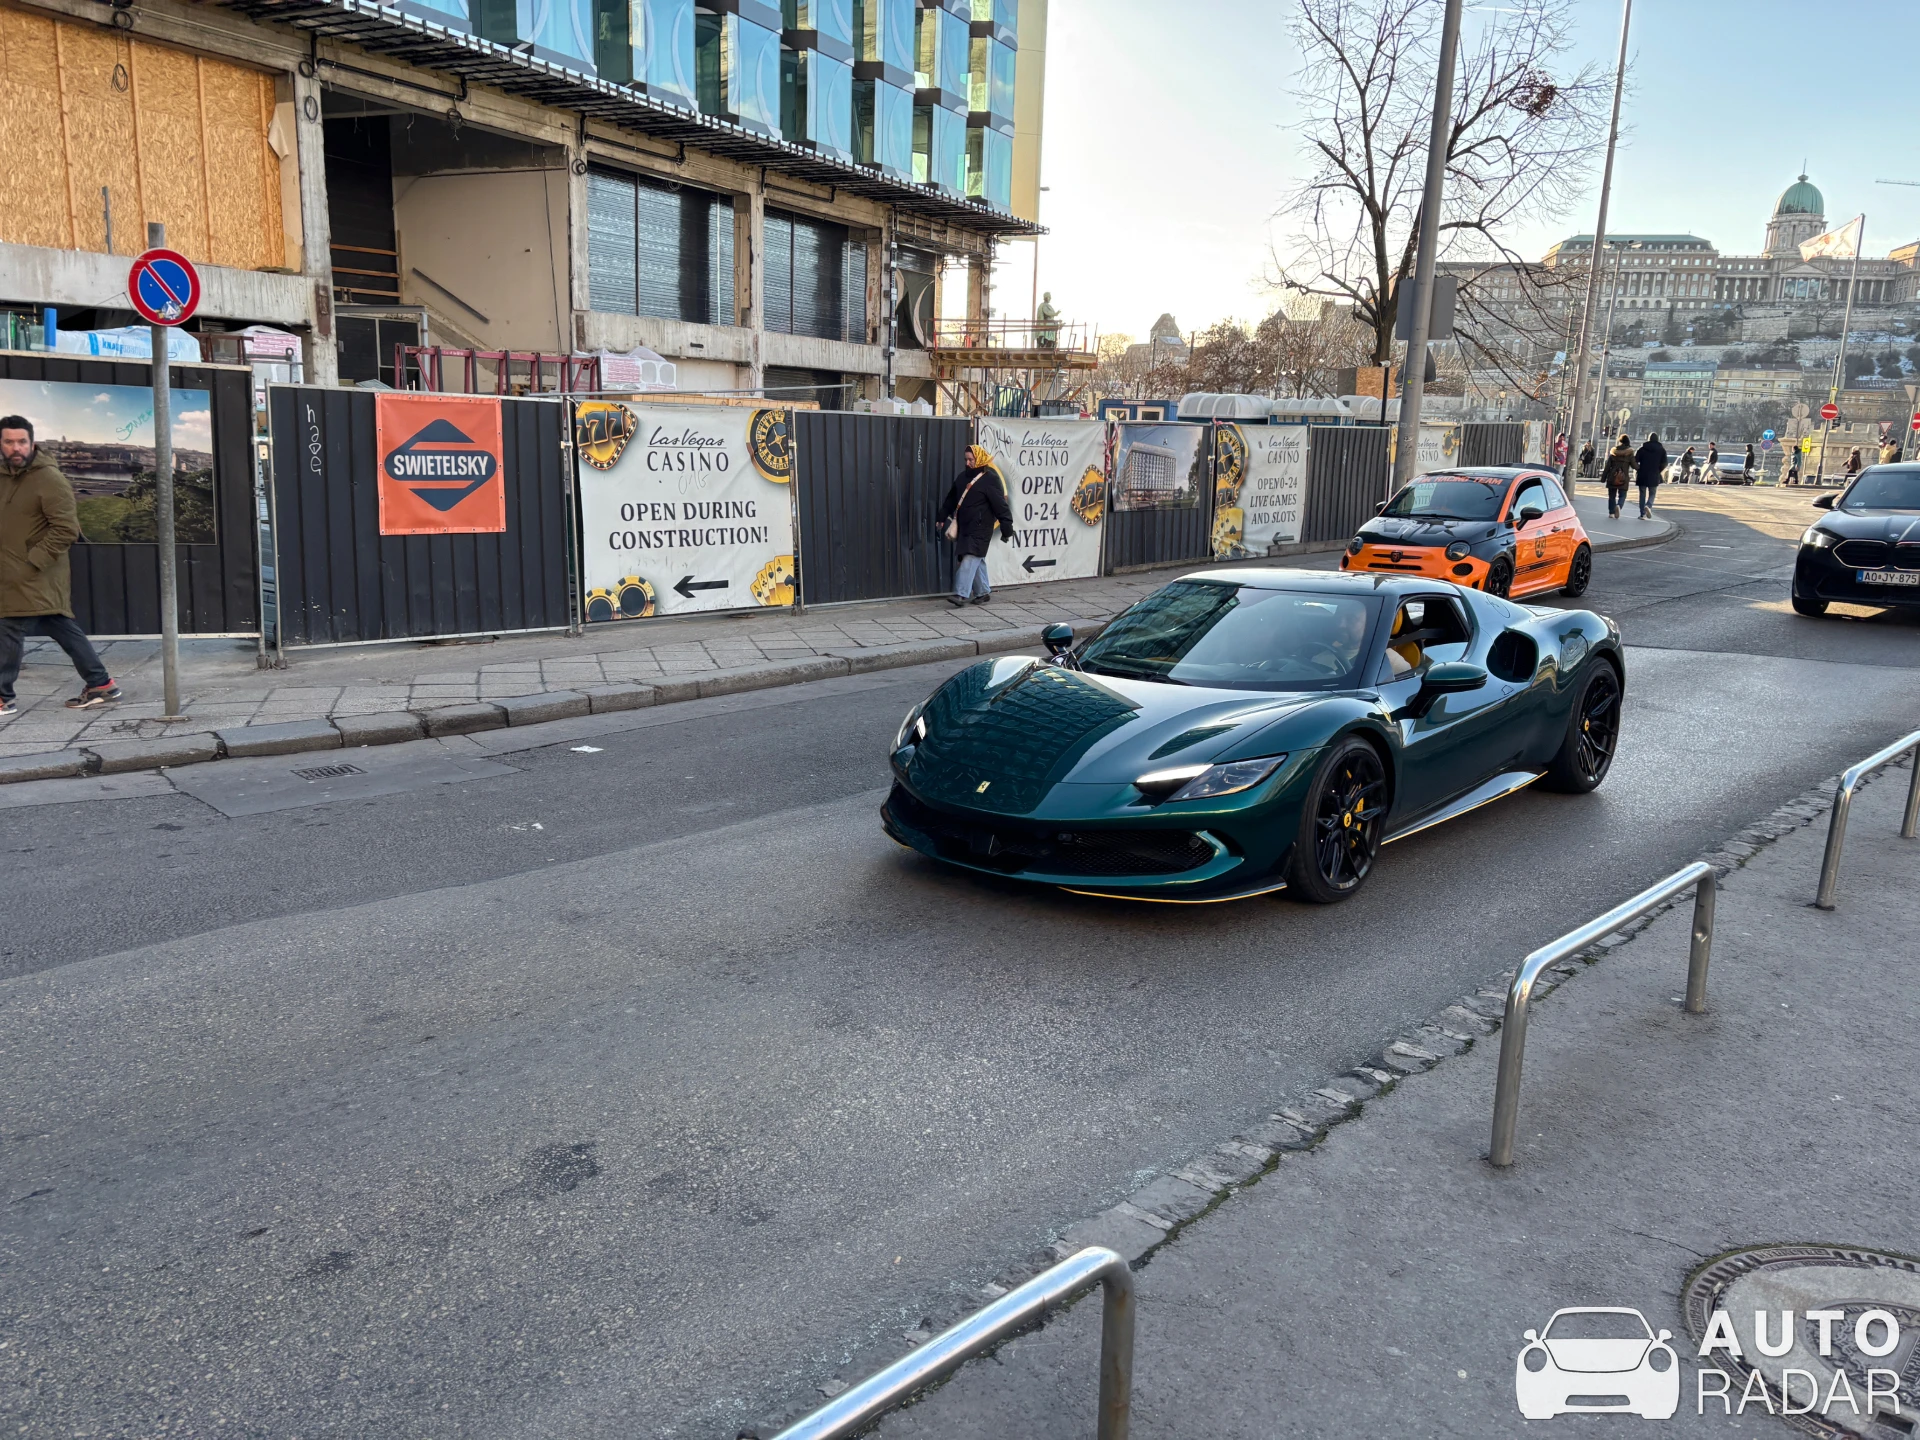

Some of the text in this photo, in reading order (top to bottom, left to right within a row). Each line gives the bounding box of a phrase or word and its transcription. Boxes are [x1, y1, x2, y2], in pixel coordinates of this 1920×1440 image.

[649, 425, 725, 450] Las Vegas
[1022, 430, 1040, 446] Las
[1040, 432, 1068, 450] Vegas
[393, 454, 489, 476] SWIETELSKY
[647, 450, 729, 472] CASINO
[1019, 449, 1069, 467] CASINO
[1267, 449, 1300, 464] CASINO
[1021, 475, 1065, 495] OPEN
[1257, 476, 1298, 490] OPEN 0-24
[1473, 477, 1503, 486] TEAM
[1249, 493, 1297, 508] LIVE GAMES
[620, 500, 757, 522] OPEN DURING
[1024, 502, 1060, 521] 0-24
[1251, 510, 1297, 525] AND SLOTS
[608, 526, 769, 550] CONSTRUCTION!
[1011, 527, 1069, 549] NYITVA
